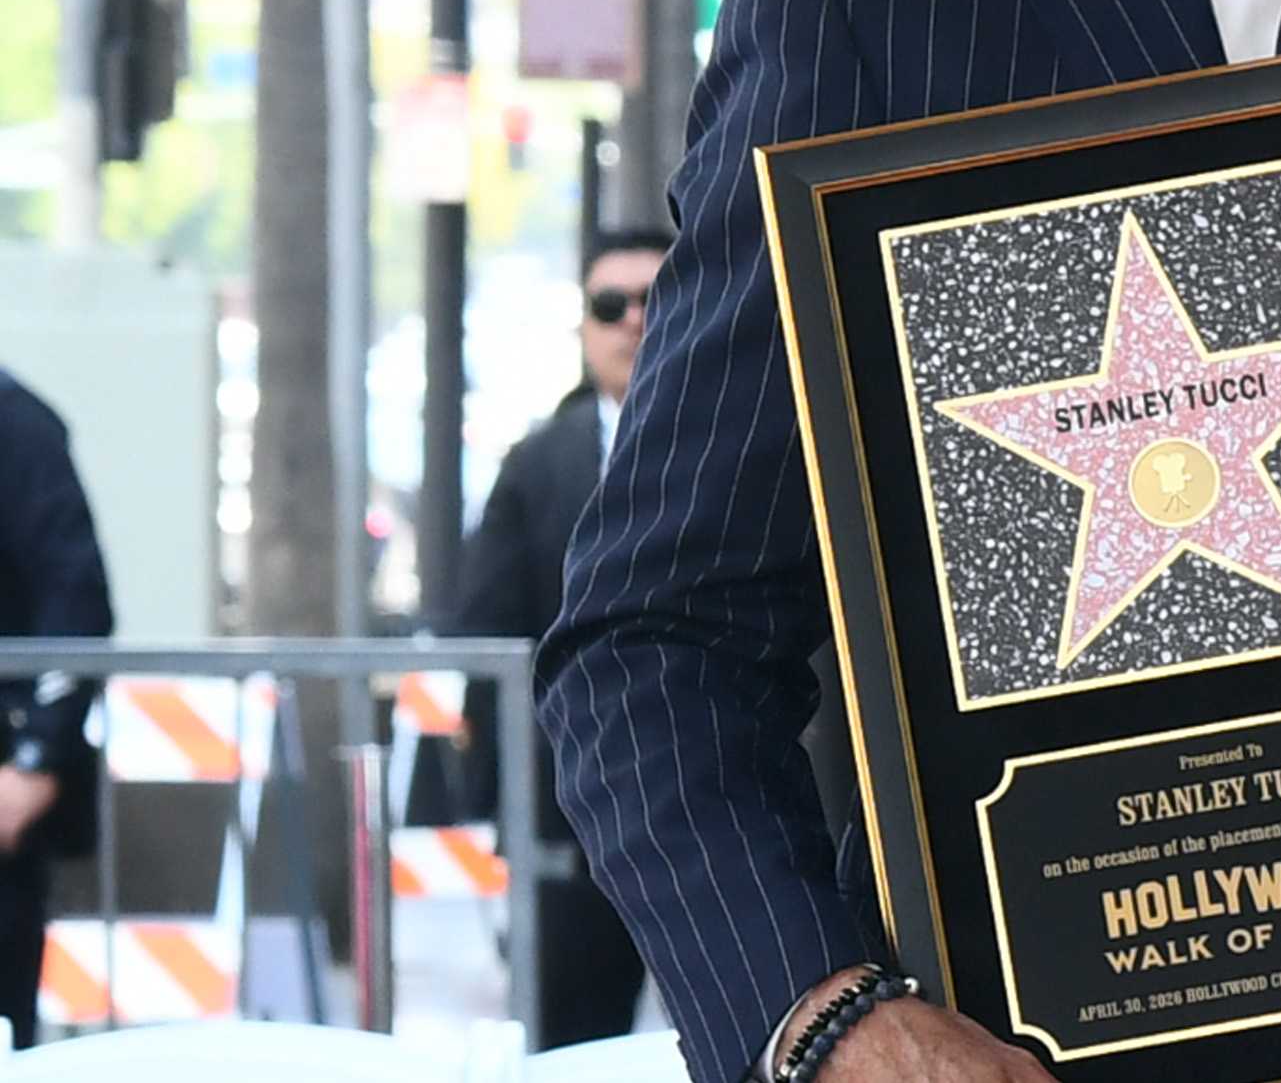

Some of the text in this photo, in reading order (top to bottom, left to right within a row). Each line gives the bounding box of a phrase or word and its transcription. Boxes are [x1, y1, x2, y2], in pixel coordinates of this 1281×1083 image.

[1055, 373, 1267, 432] STANLEY TUCCI
[1179, 743, 1263, 770] Presented To
[1117, 776, 1247, 825] STANLEY
[1043, 862, 1062, 878] on
[1066, 857, 1089, 873] the
[1094, 845, 1160, 869] occasion
[1163, 838, 1179, 856] of
[1182, 835, 1207, 854] the
[1105, 934, 1214, 974] WALK
[1227, 924, 1274, 953] OF
[1078, 1002, 1122, 1022] APRIL
[1124, 997, 1146, 1015] 30,
[1150, 990, 1183, 1009] 2026
[1186, 975, 1268, 1003] HOLLYWOOD
